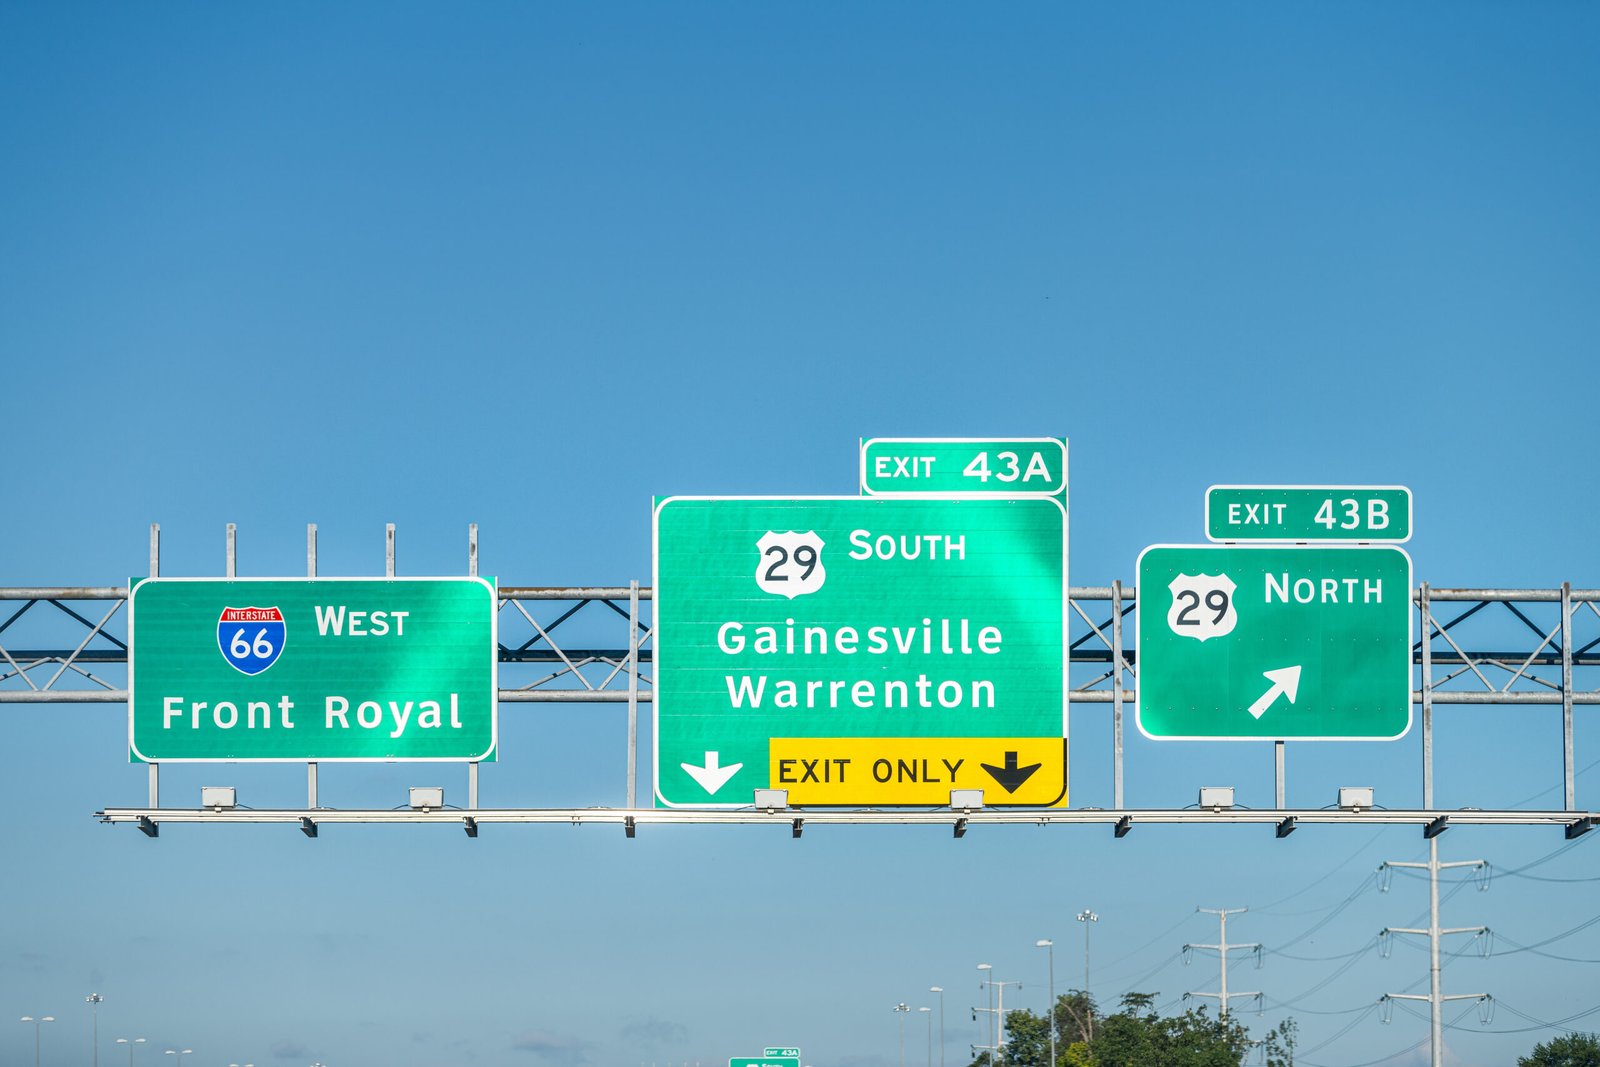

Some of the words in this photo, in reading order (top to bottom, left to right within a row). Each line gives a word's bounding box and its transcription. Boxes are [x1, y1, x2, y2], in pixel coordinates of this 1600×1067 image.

[876, 457, 936, 477] EXIT
[963, 452, 1051, 482] 43A
[1228, 504, 1286, 524] EXIT
[1314, 499, 1389, 529] 43B
[849, 530, 965, 560] SOUTH
[765, 545, 817, 581] 29
[1266, 573, 1381, 603] NORTH
[227, 610, 276, 621] INTERSTATE
[315, 606, 409, 635] WEST
[1177, 590, 1228, 625] 29
[231, 628, 273, 658] 66
[718, 618, 1002, 654] Gainesville
[726, 674, 994, 708] Warrenton
[164, 696, 294, 728] Front
[326, 694, 462, 738] Royal
[780, 759, 850, 783] EXIT
[873, 759, 964, 783] ONLY
